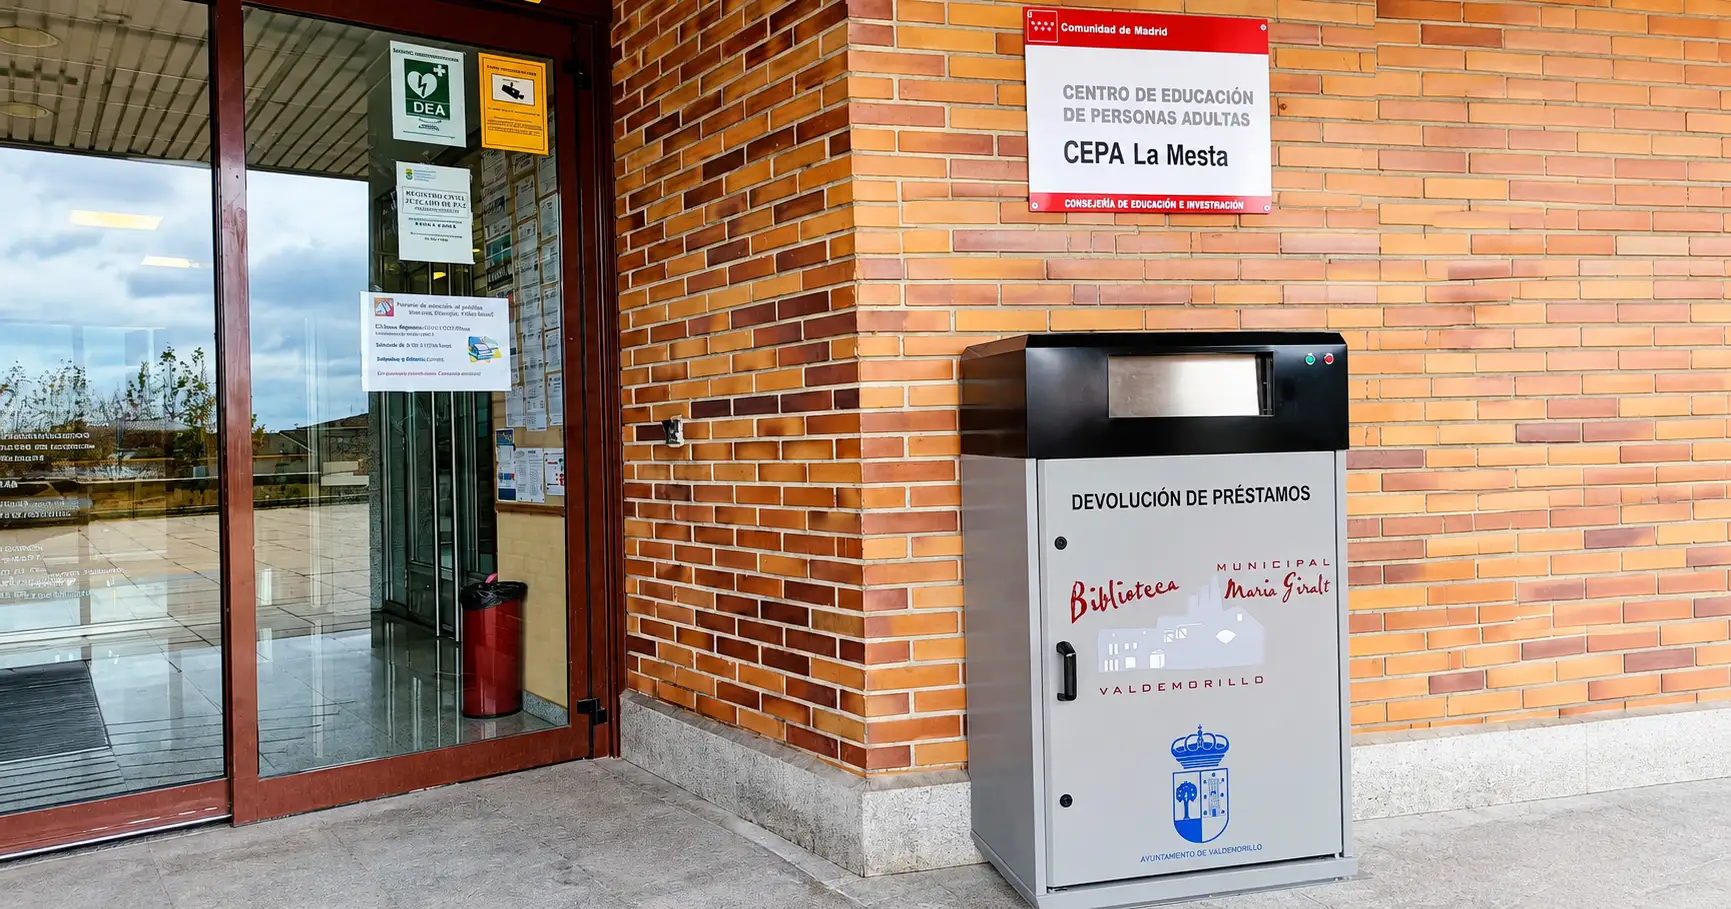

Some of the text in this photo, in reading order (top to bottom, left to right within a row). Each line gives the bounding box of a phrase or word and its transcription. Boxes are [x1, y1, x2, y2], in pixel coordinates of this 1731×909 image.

[1061, 23, 1168, 36] Comunidad de Madrid
[1063, 85, 1253, 104] CENTRO DE EDUCACIÓN
[414, 101, 445, 116] DEA
[1064, 107, 1250, 127] DE PERSONAS ADULTAS
[1064, 140, 1228, 167] CEPA La Mesta
[1118, 199, 1128, 208] DE
[1131, 198, 1176, 209] EDUCACIÓN
[1179, 200, 1184, 209] E
[1072, 485, 1310, 510] DEVOLUCIÓN DE PRÉSTAMOS
[1217, 559, 1330, 571] MUNICIPAL
[1282, 572, 1330, 603] Giralt
[1070, 579, 1179, 624] Biblioteca
[1100, 676, 1264, 696] VALDEMORILLO
[1140, 850, 1195, 862] AYUNTAMIENTO
